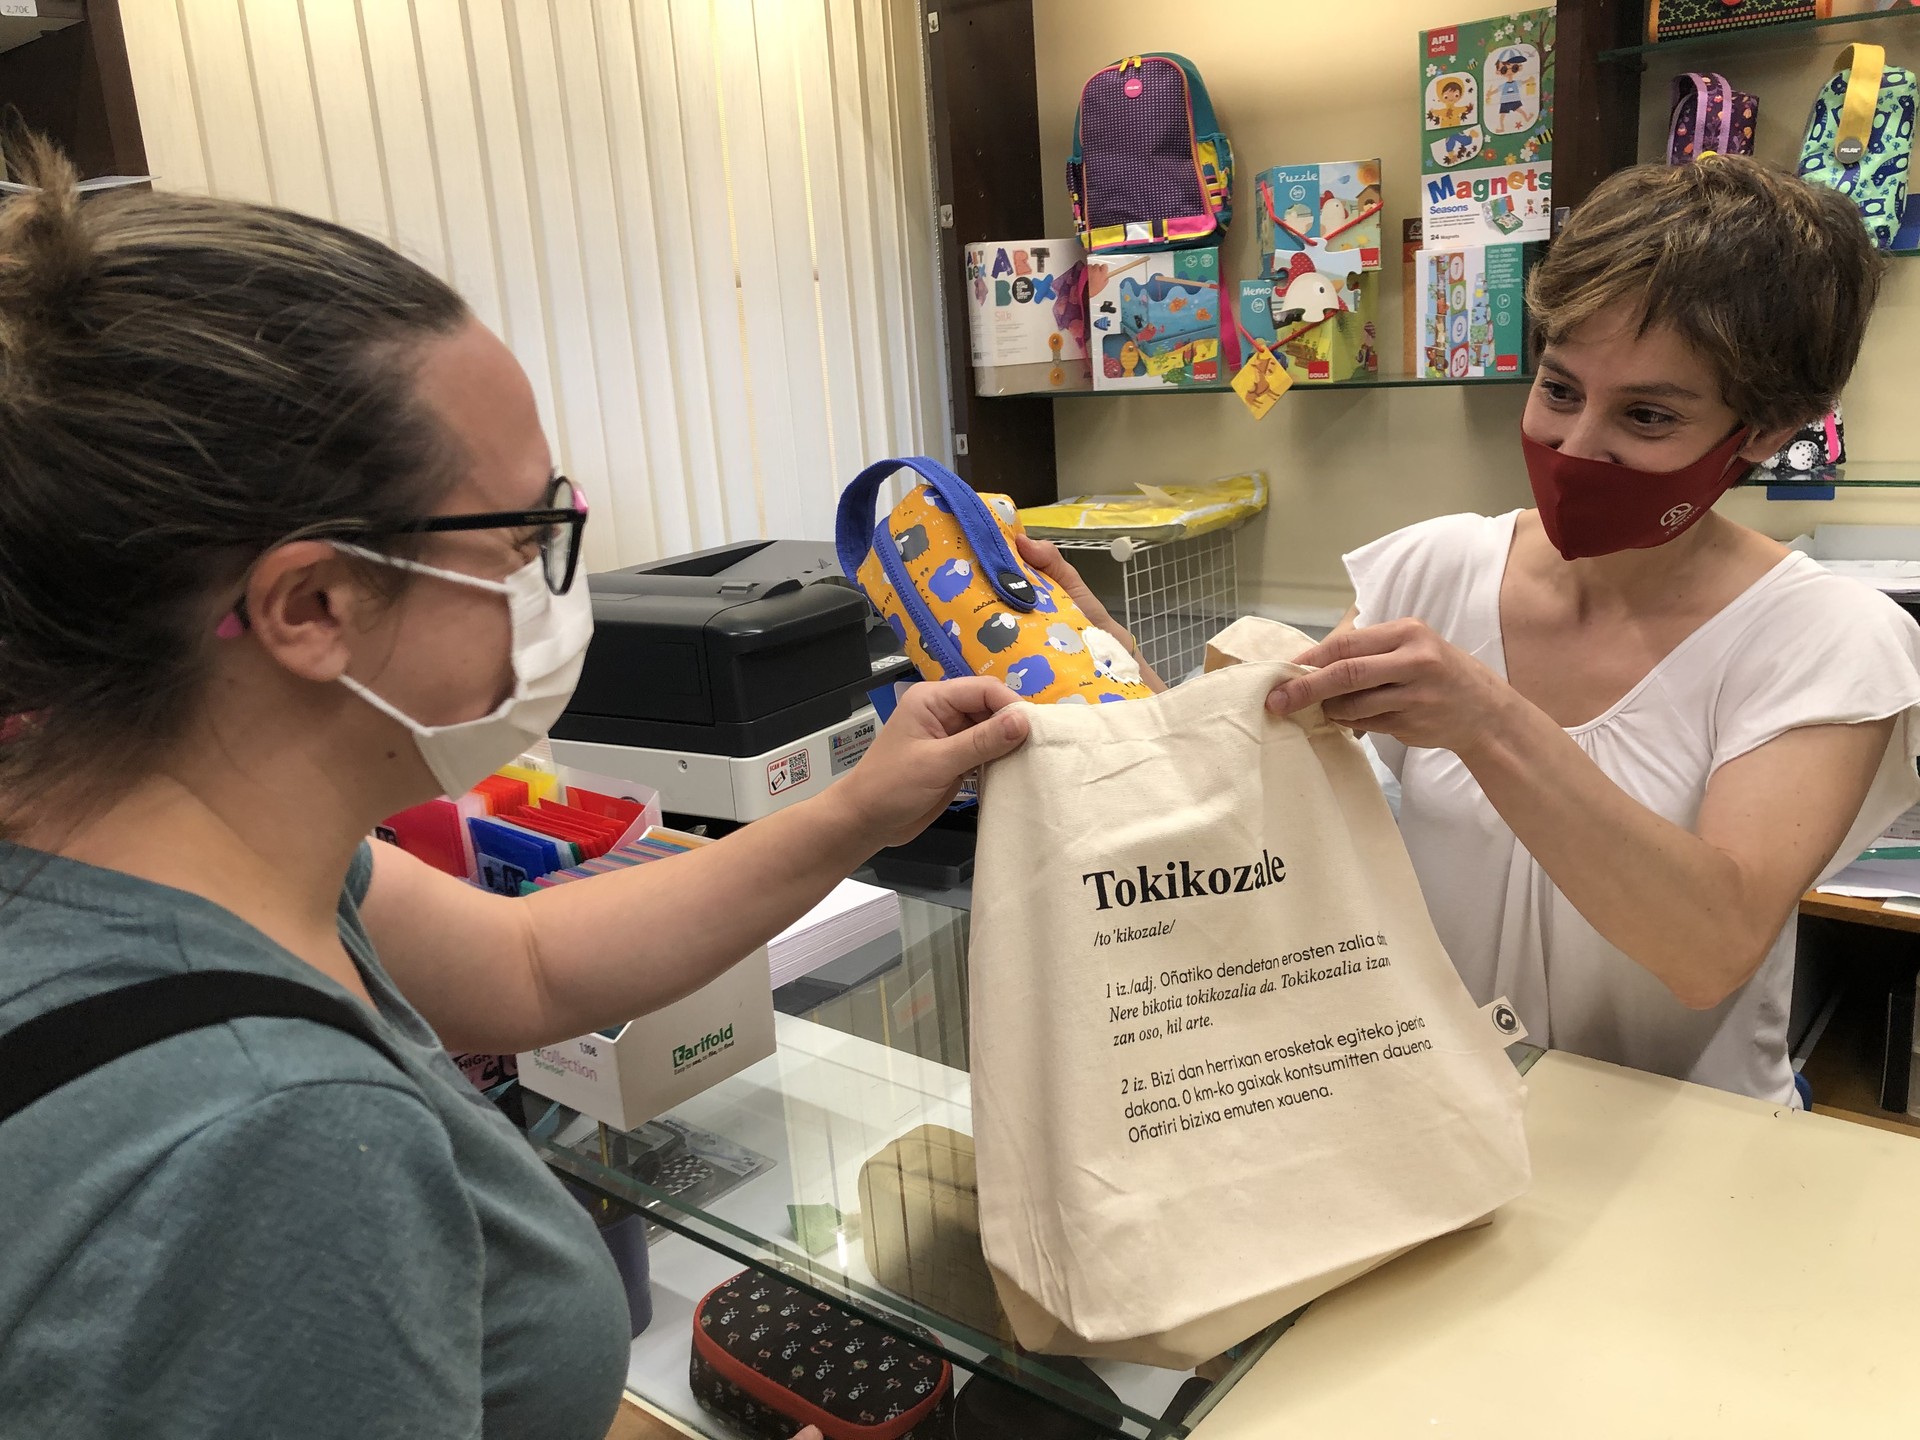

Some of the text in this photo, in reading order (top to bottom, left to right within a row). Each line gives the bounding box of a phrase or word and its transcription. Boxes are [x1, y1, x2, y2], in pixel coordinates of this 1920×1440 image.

[1431, 34, 1454, 46] APLI
[1278, 170, 1319, 183] Puzzle
[1427, 169, 1552, 204] Magnets
[1430, 204, 1469, 215] Seasons
[991, 247, 1050, 279] ART
[1454, 262, 1460, 274] 7
[1243, 286, 1271, 297] Memo
[1455, 290, 1462, 305] 8
[1456, 322, 1463, 337] 9
[1454, 354, 1466, 372] 10
[769, 763, 780, 772] SCAN
[1082, 849, 1286, 911] Tokikozale
[1116, 976, 1157, 996] iz./adj.
[1160, 966, 1213, 987] Oñatiko
[1216, 957, 1280, 979] dendetan
[1281, 944, 1336, 966] erosten
[1338, 934, 1376, 953] zalia
[1109, 956, 1391, 1023] Nere bikotia tokikozalia da. Tokikozalia izan
[1113, 1016, 1214, 1047] zan oso, hil arte.
[1121, 1078, 1129, 1095] 2
[1133, 1077, 1148, 1092] iz.
[1151, 1069, 1176, 1088] Bizi
[1178, 1064, 1205, 1081] dan
[1205, 1053, 1262, 1074] herrixan
[1264, 1034, 1335, 1062] erosketak
[1337, 1023, 1394, 1048] egiteko
[1124, 1096, 1181, 1119] dakona.
[1193, 1081, 1235, 1102] km-ko
[1237, 1070, 1283, 1096] gaixak
[1283, 1051, 1380, 1082] kontsumitten
[1383, 1039, 1434, 1060] dauena.
[1128, 1085, 1333, 1143] Oñatiri bizixa emuten xauena.
